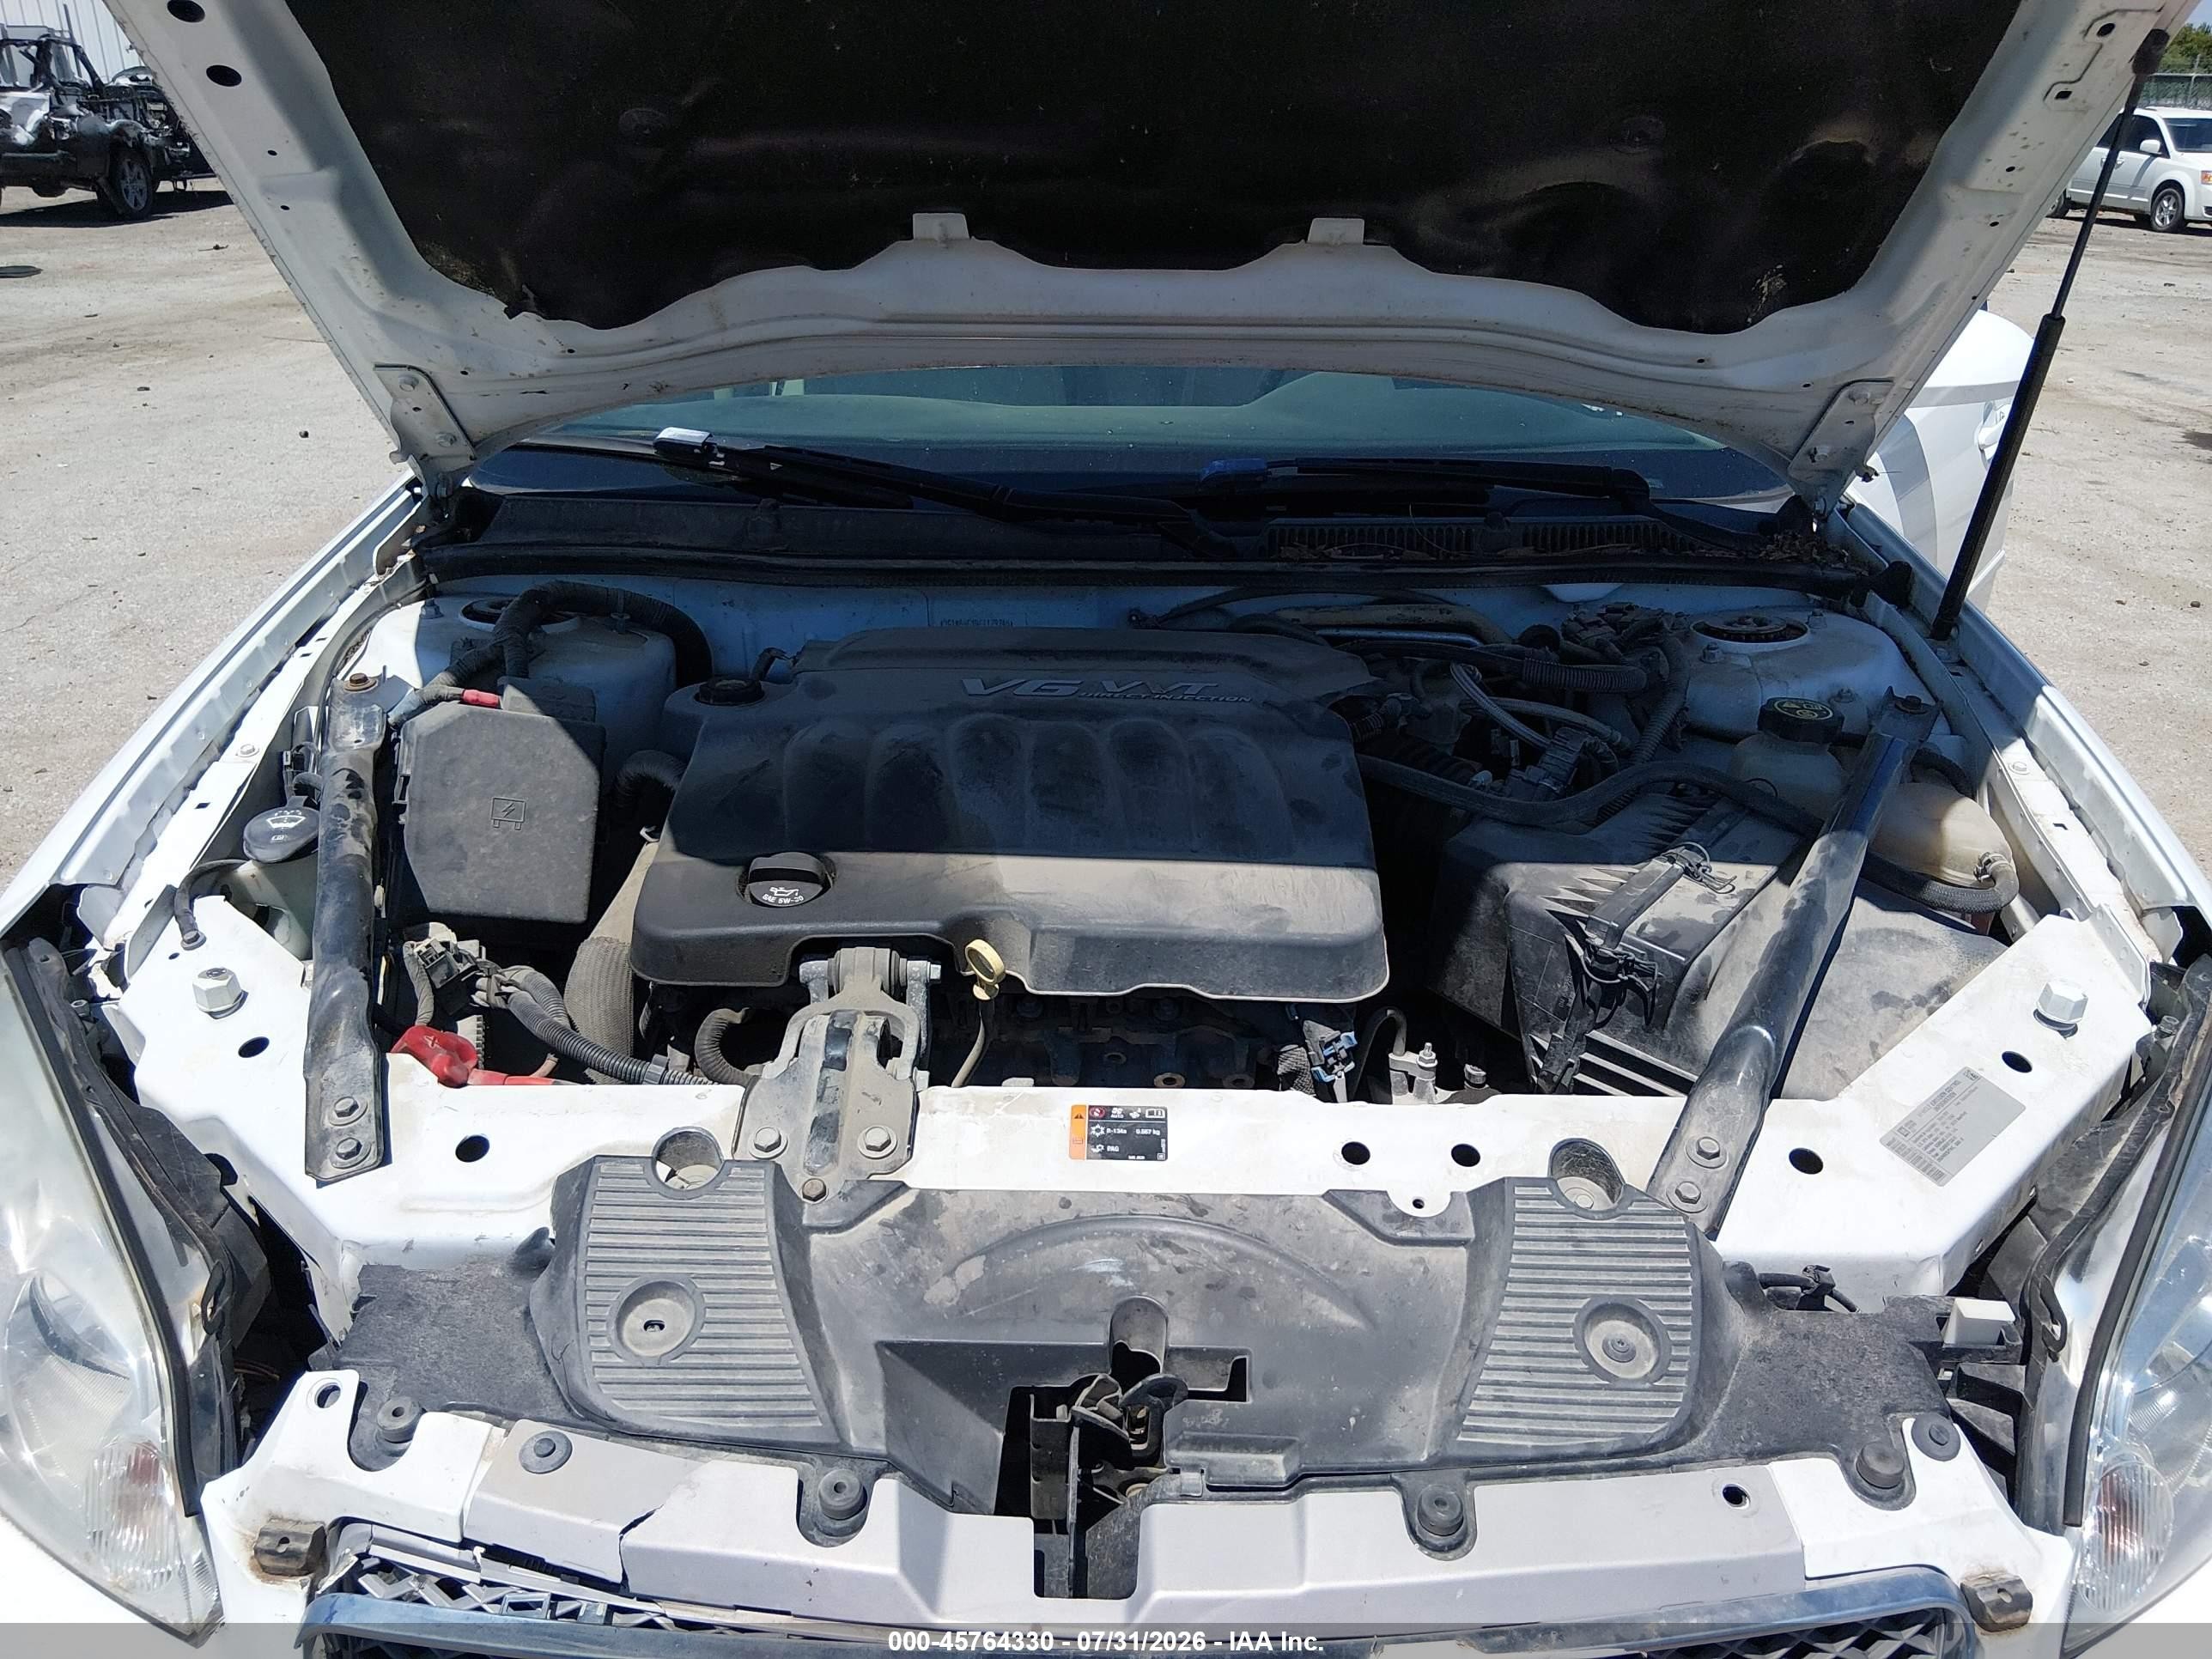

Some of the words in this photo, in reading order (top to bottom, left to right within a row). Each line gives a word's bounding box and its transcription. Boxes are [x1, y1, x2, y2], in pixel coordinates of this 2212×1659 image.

[961, 678, 1084, 696] V6
[1102, 679, 1218, 695] VVT
[1150, 694, 1252, 702] INJECTION
